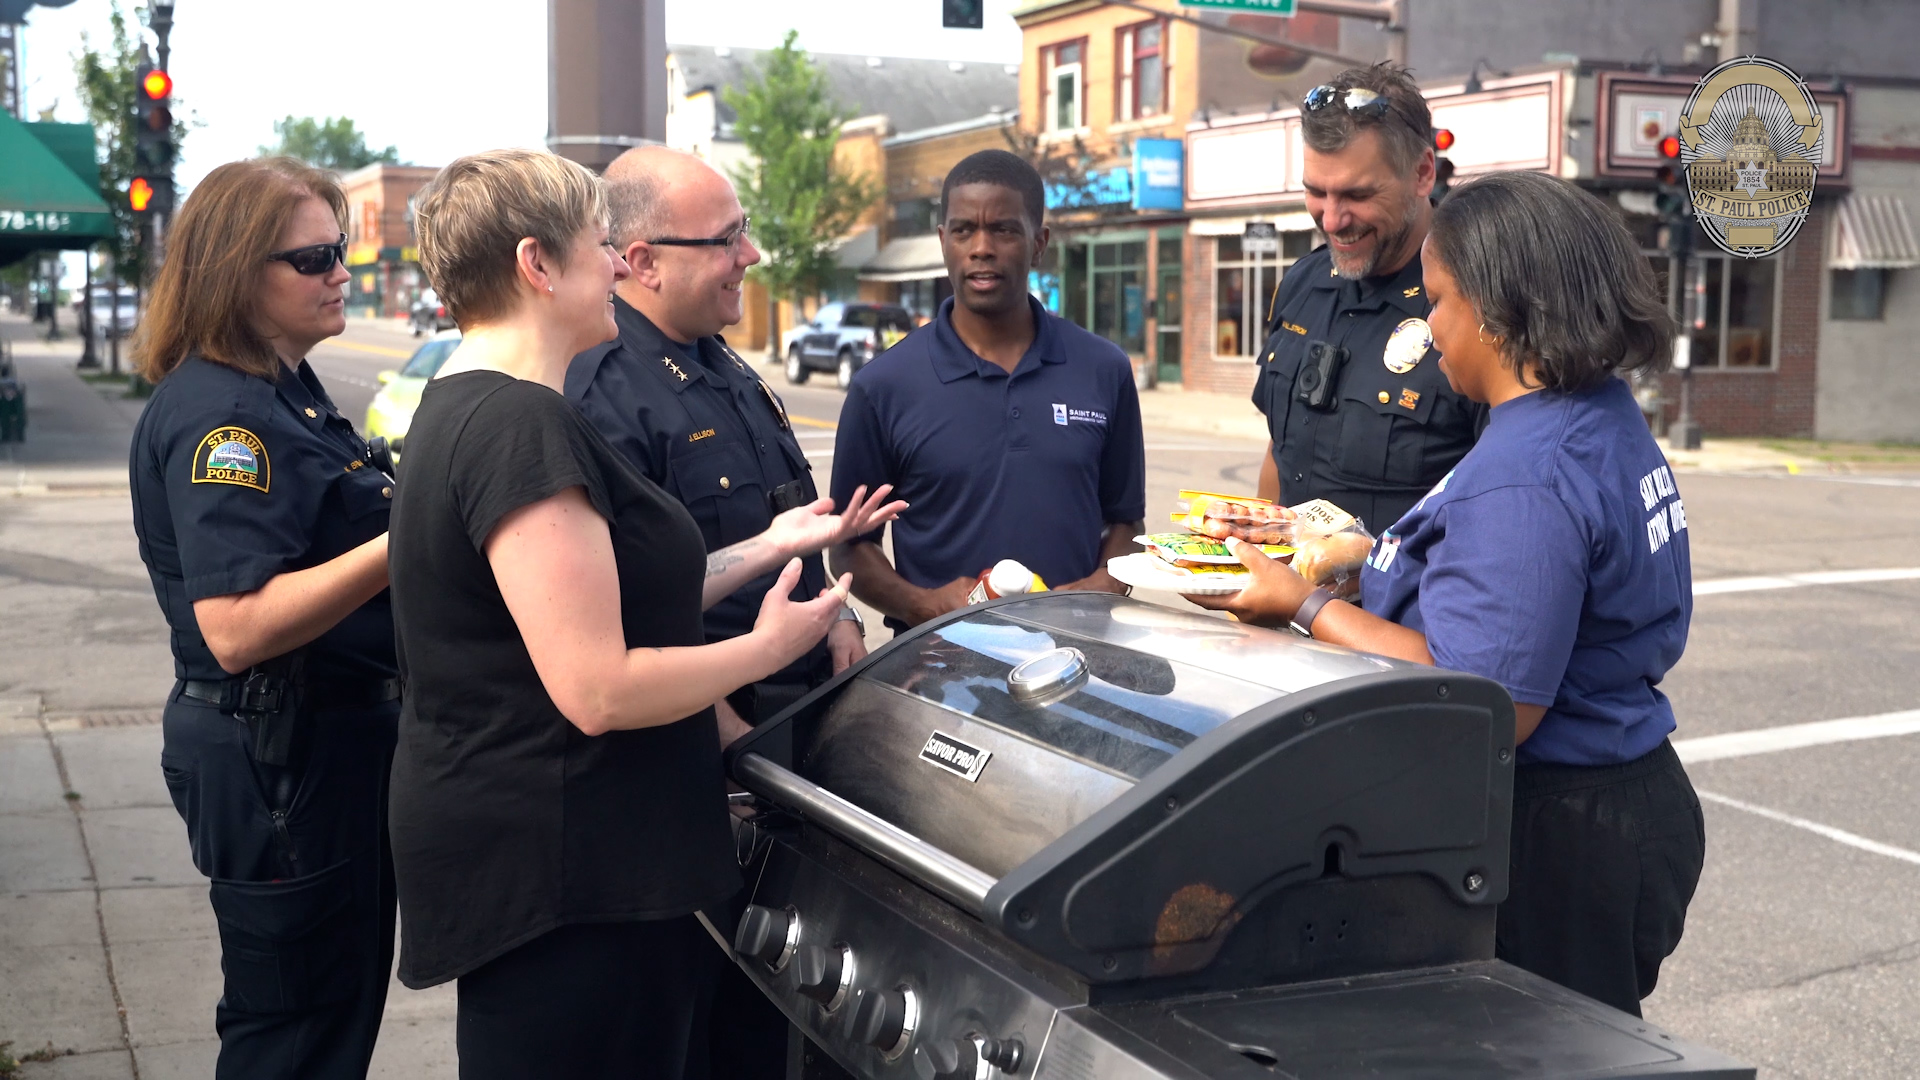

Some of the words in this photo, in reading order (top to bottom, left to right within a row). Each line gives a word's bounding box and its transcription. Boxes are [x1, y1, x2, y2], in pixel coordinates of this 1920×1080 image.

[1069, 409, 1091, 418] SAINT
[1091, 411, 1107, 420] PAUL
[207, 432, 227, 450] ST.
[229, 430, 261, 456] PAUL
[206, 468, 257, 484] POLICE
[925, 738, 957, 762] SAVOR
[952, 749, 975, 769] PRO
